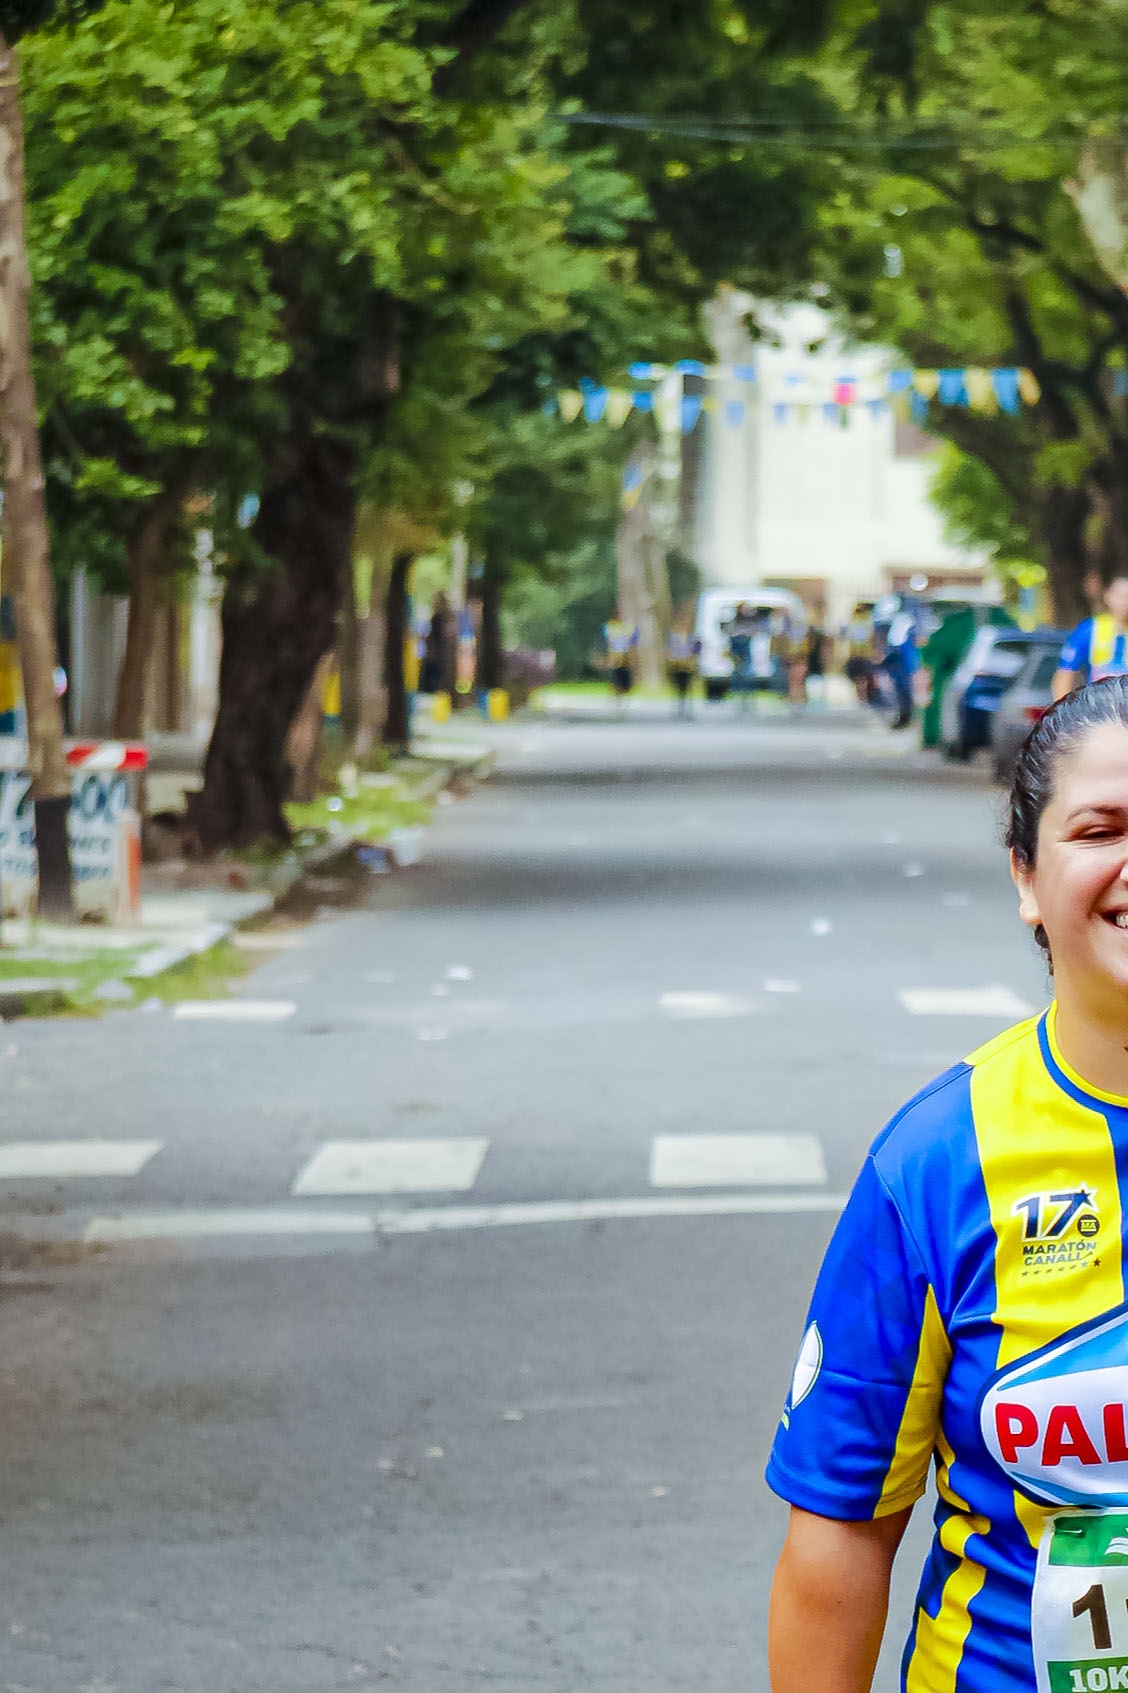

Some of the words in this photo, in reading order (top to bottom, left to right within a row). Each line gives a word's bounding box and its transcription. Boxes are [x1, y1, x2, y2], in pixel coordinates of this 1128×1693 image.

[1012, 1185, 1097, 1241] 17
[1022, 1240, 1097, 1255] MARATÓN
[1024, 1251, 1092, 1266] CANALL
